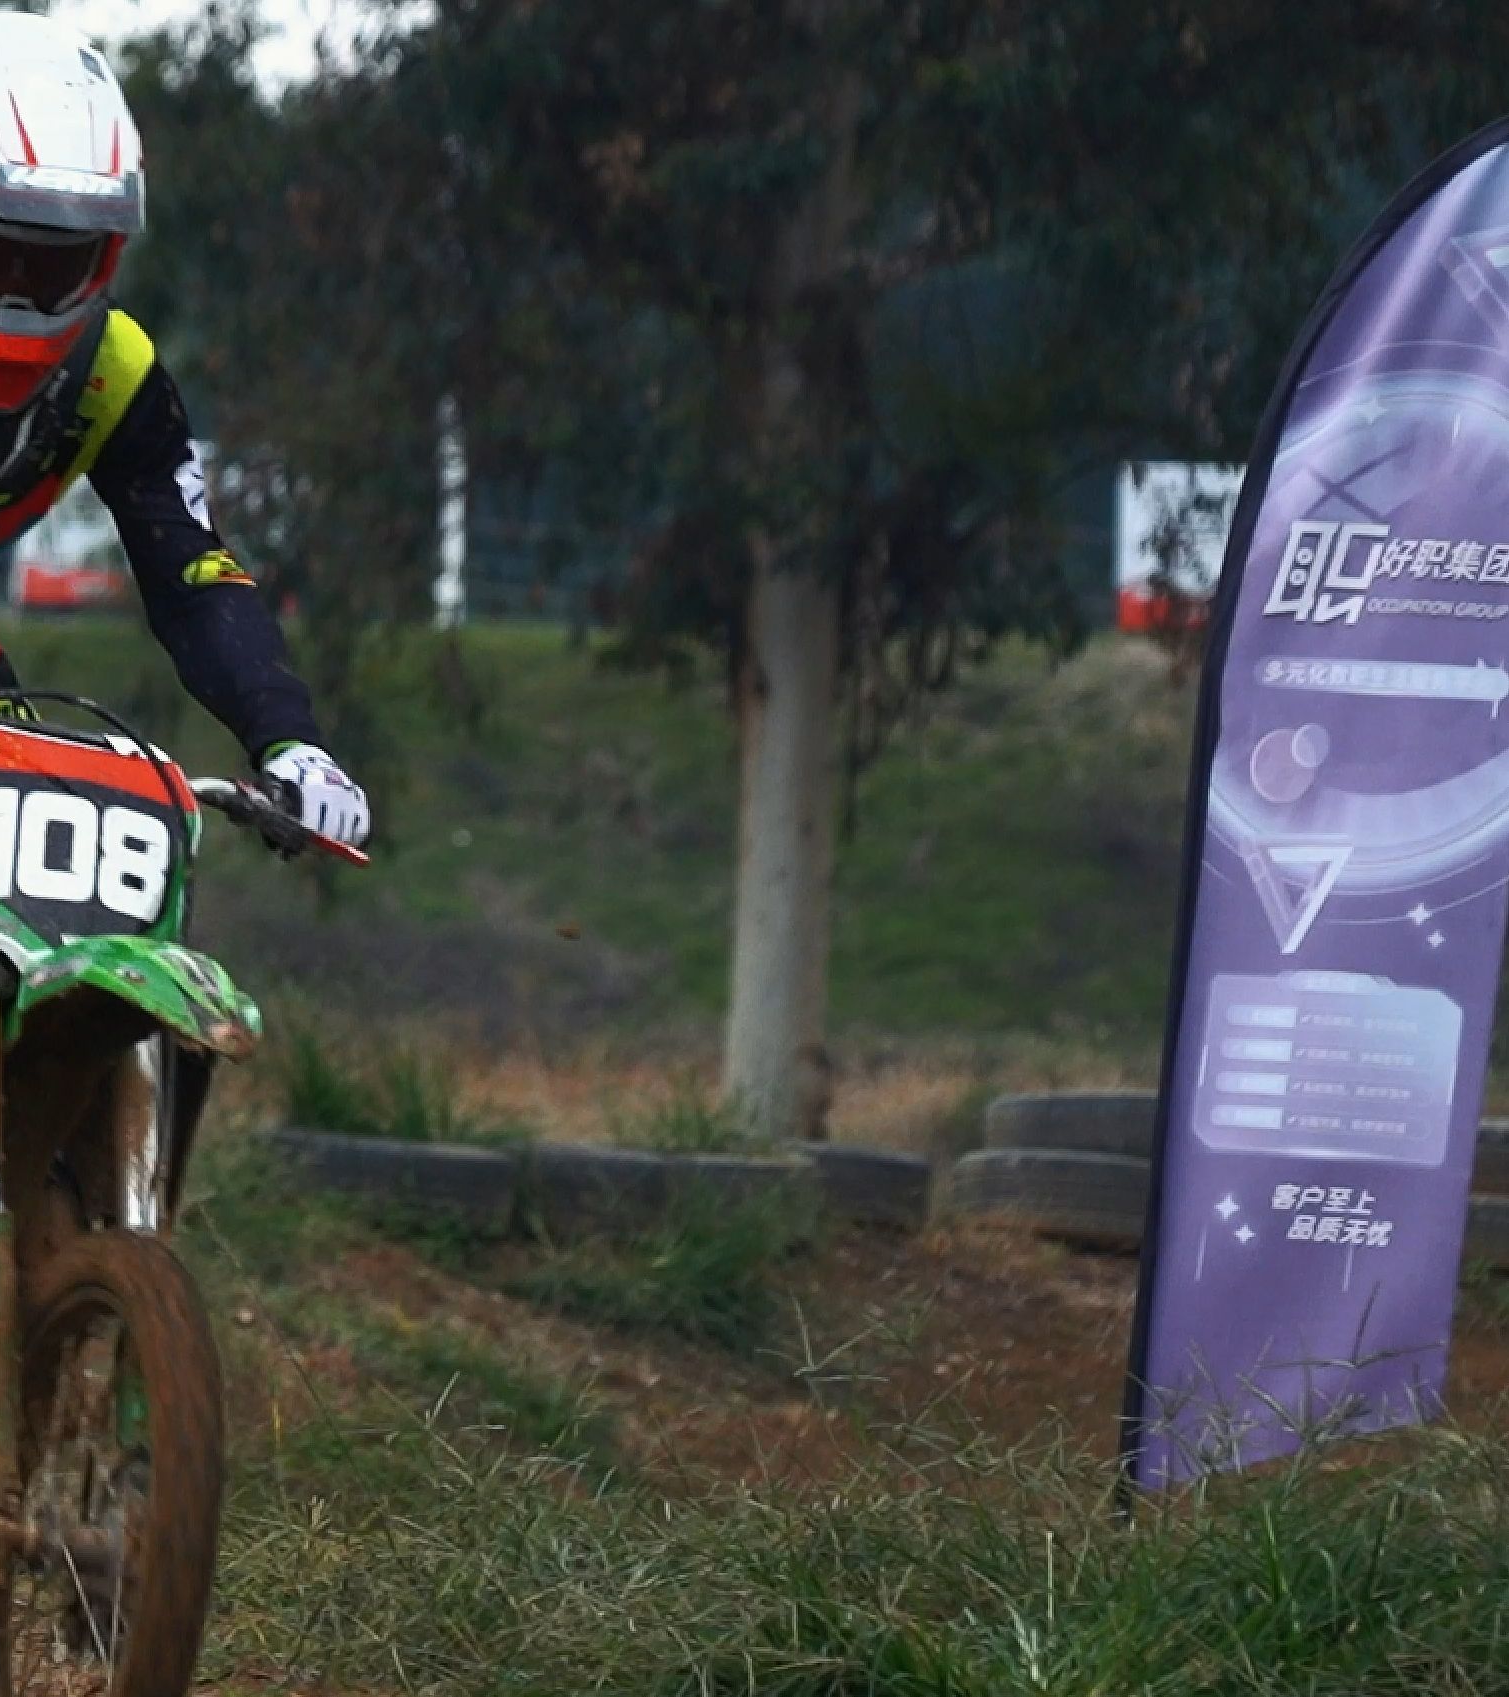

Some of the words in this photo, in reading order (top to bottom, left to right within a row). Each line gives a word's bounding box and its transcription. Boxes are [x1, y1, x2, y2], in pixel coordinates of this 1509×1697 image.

[1374, 537, 1509, 584] 好职集团
[1367, 598, 1453, 615] OCCUPATION
[1271, 1183, 1377, 1216] 客户至上
[1286, 1215, 1393, 1247] 品质无忧
